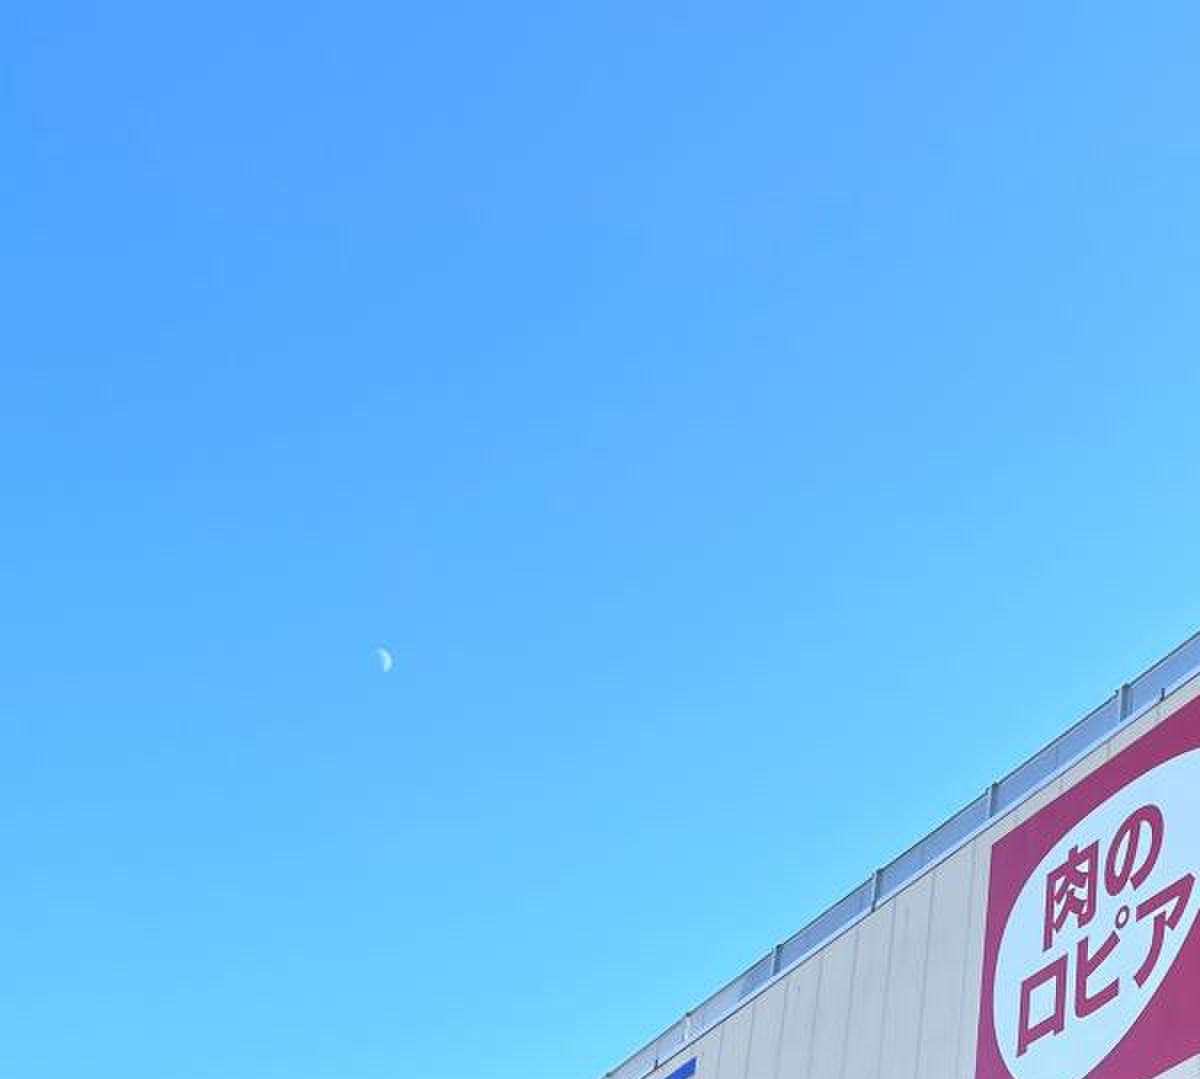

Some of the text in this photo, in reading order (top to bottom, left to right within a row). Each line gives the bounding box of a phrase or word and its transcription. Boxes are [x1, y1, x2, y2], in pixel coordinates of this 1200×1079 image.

[1041, 804, 1165, 955] 肉の
[1015, 872, 1195, 1058] ロピア
